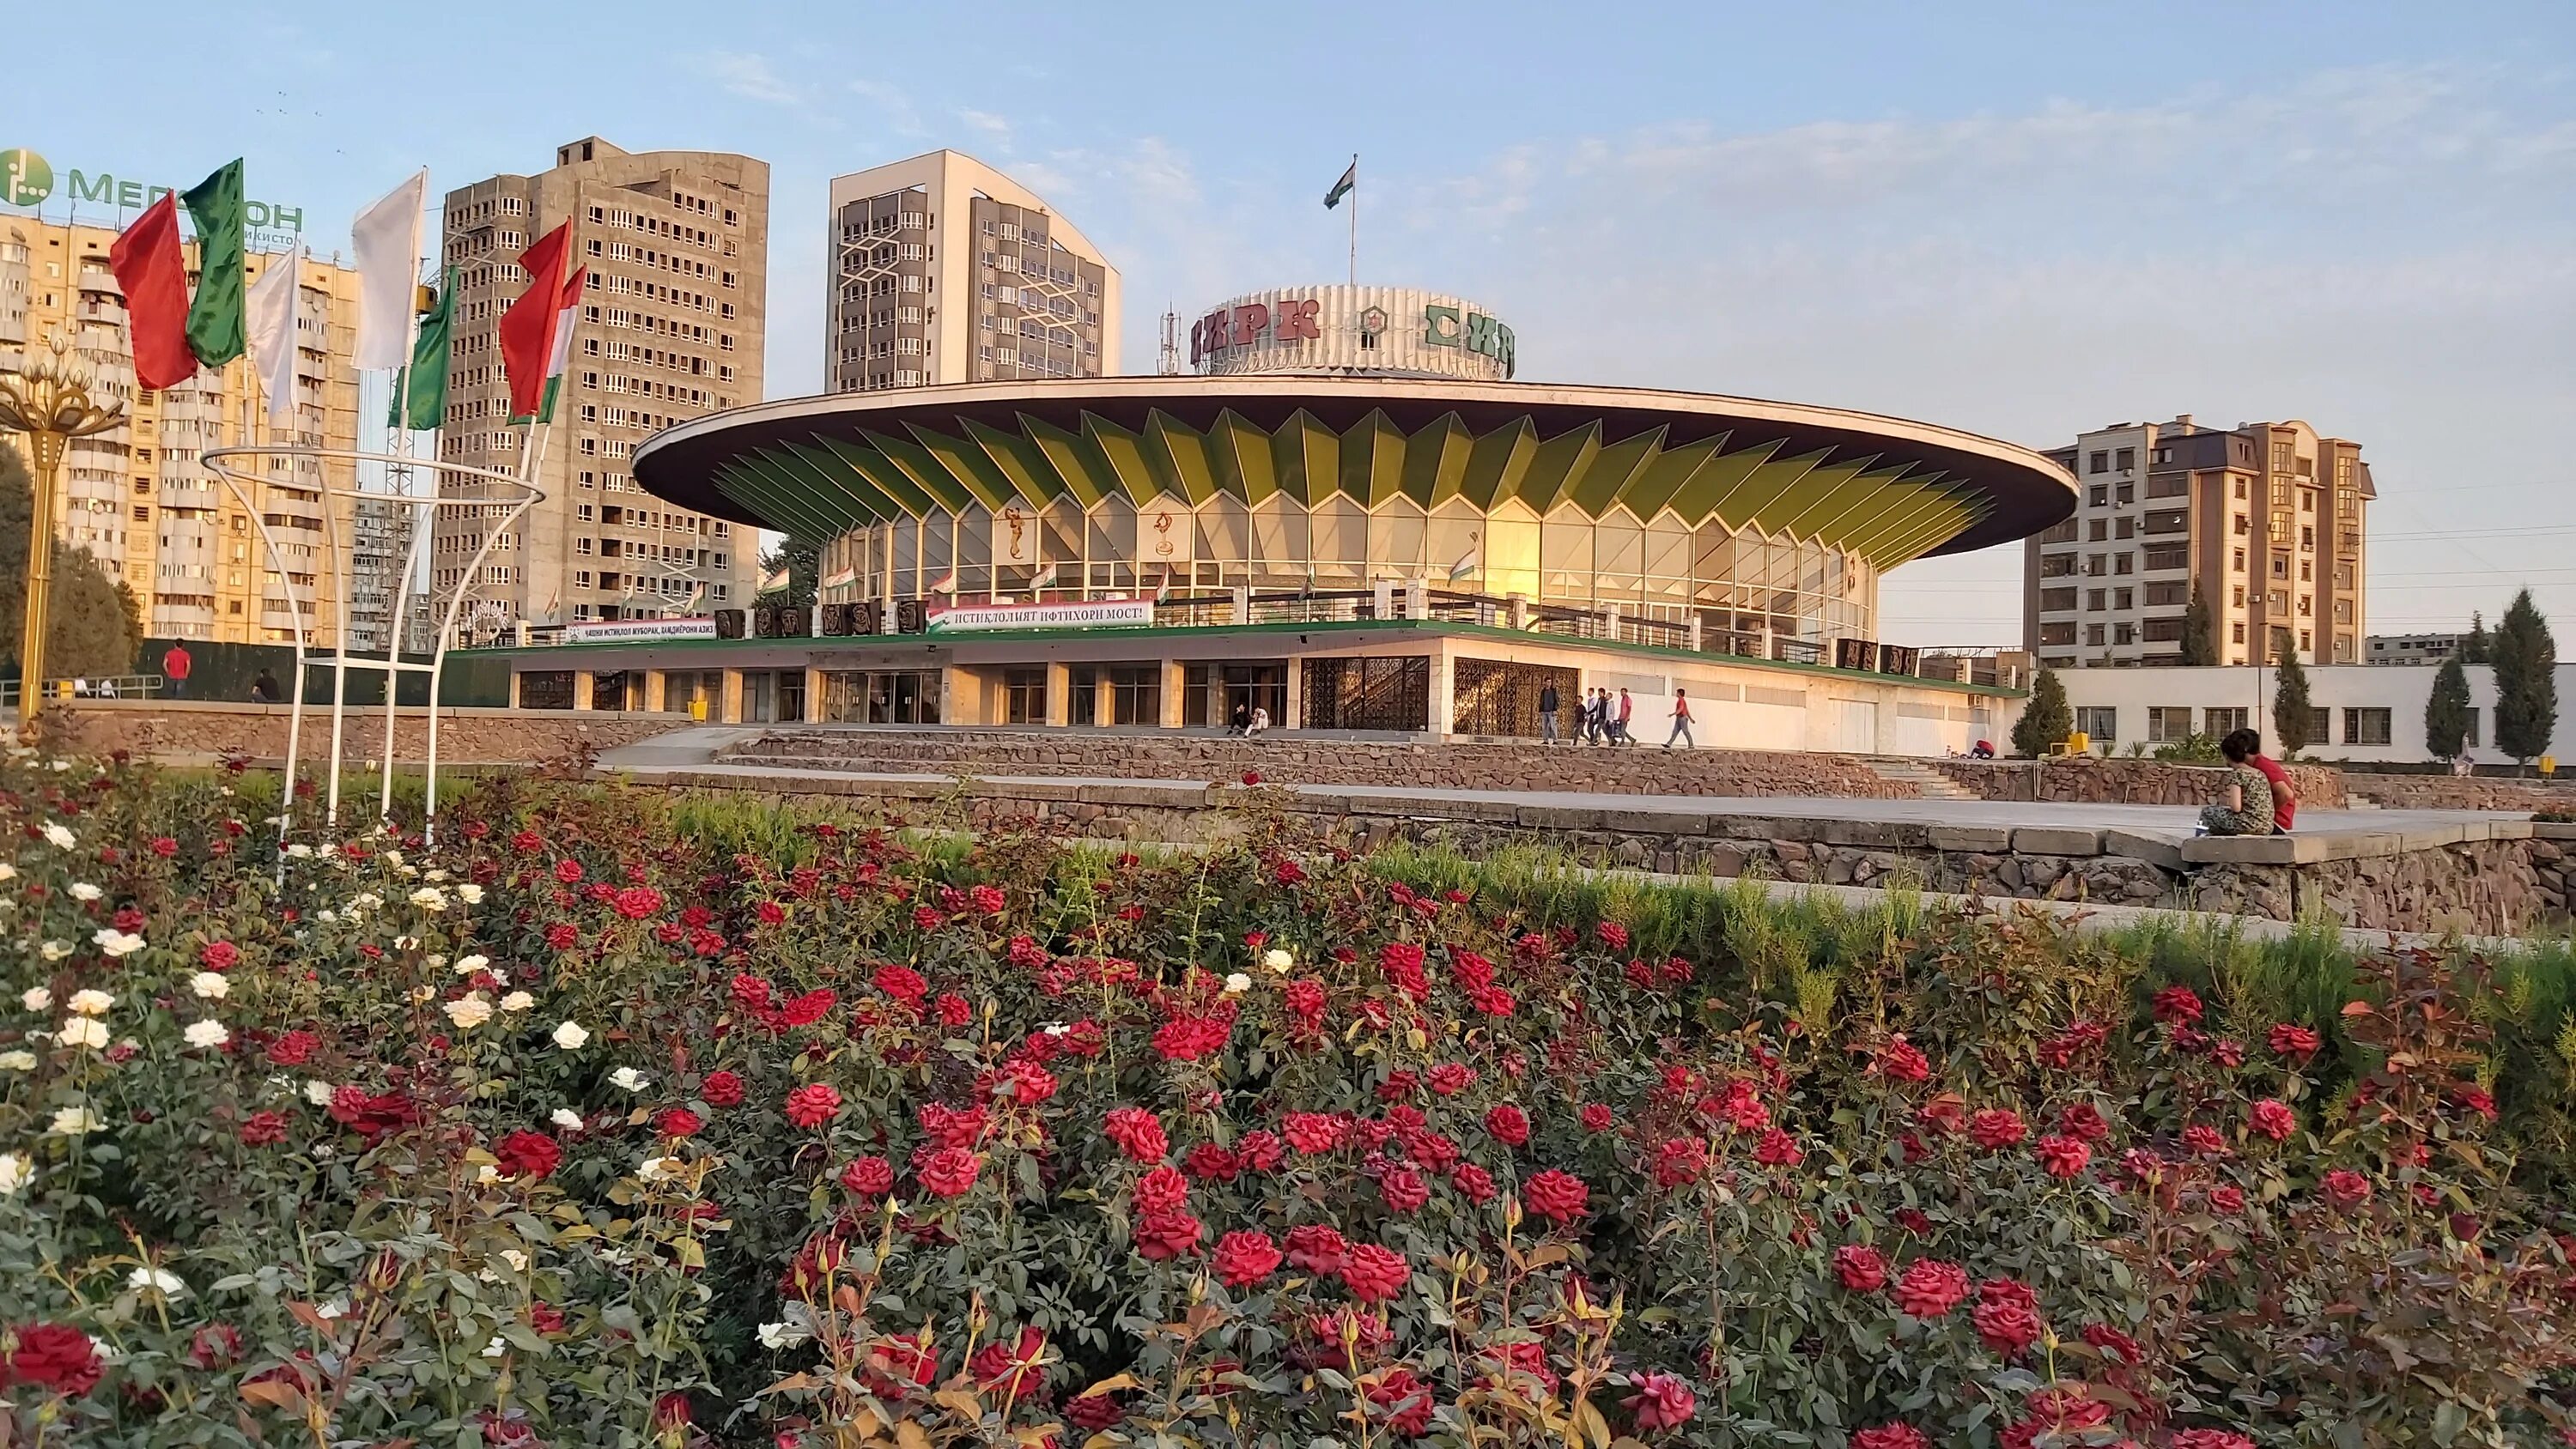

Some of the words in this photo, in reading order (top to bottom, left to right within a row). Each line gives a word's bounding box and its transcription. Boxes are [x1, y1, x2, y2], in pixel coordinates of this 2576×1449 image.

[69, 169, 302, 233] МЕГОН
[1425, 305, 1515, 379] СИР
[1040, 609, 1103, 622] ИФТИХОРИ
[1106, 607, 1143, 619] МОСТ!
